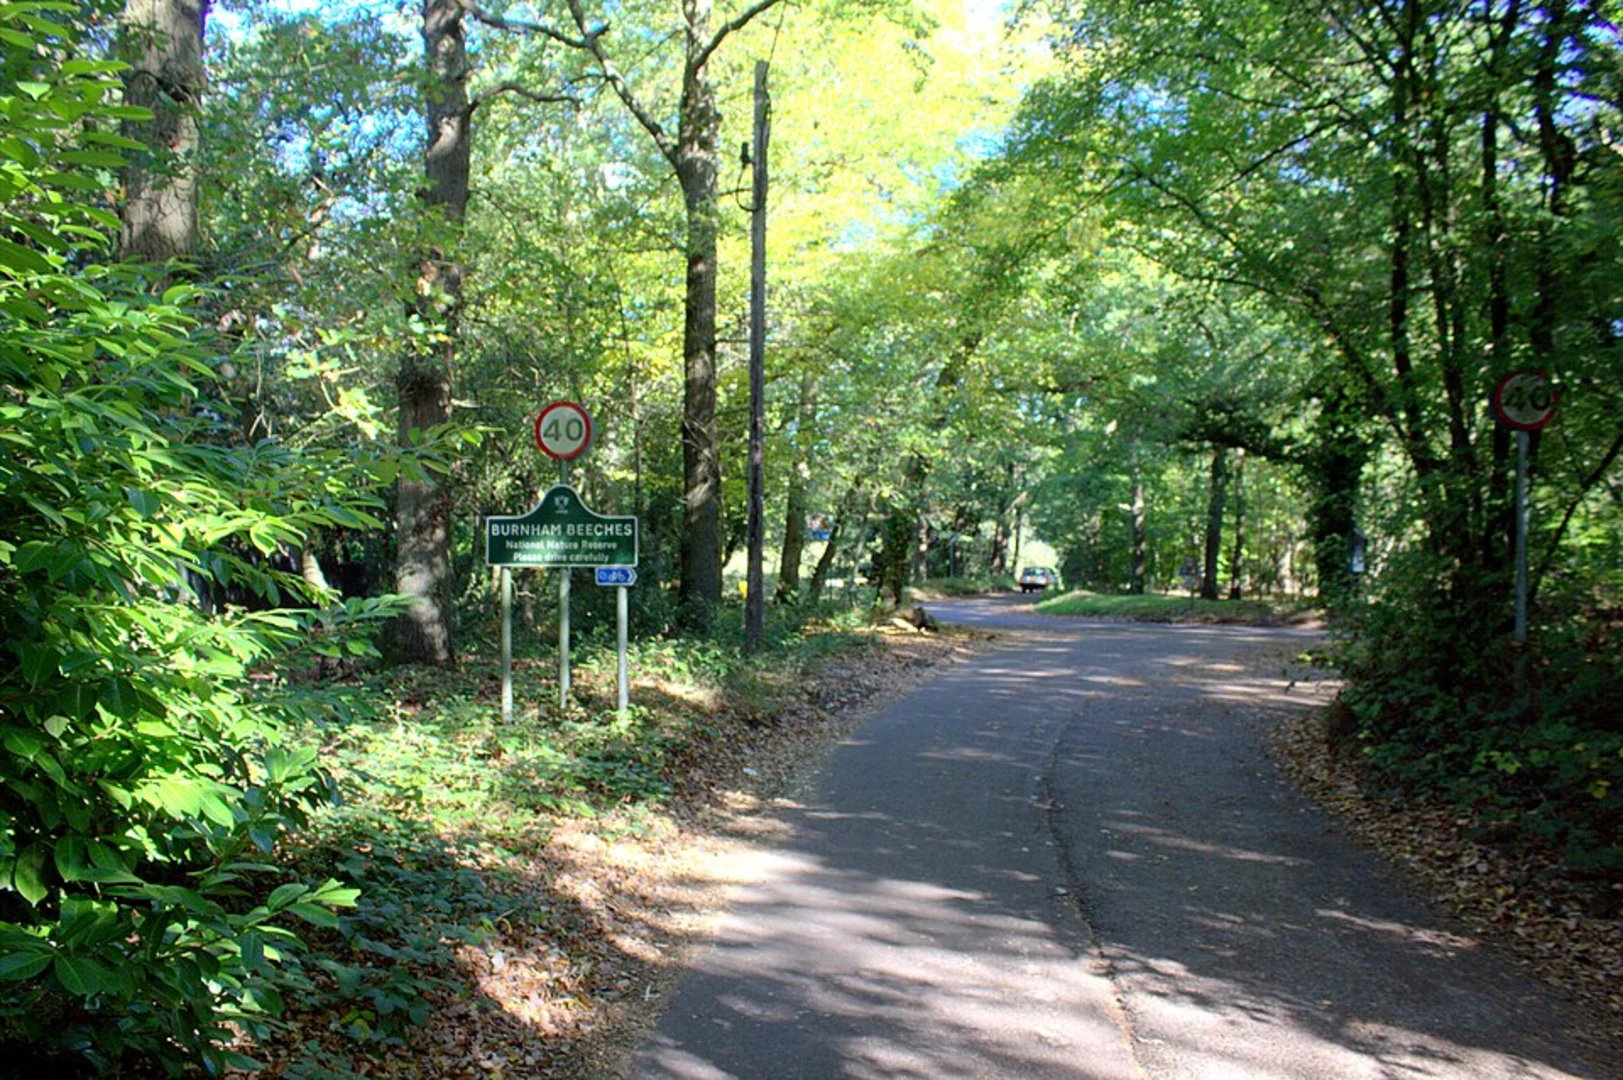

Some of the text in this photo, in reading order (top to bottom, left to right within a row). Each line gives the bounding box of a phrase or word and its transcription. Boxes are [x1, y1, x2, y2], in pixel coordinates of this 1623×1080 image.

[1503, 385, 1551, 411] 40
[543, 418, 584, 442] 40
[491, 523, 633, 537] BURNHAM BEECHES
[505, 540, 617, 550] National Nature Reserve
[513, 550, 610, 564] Please drive carefully
